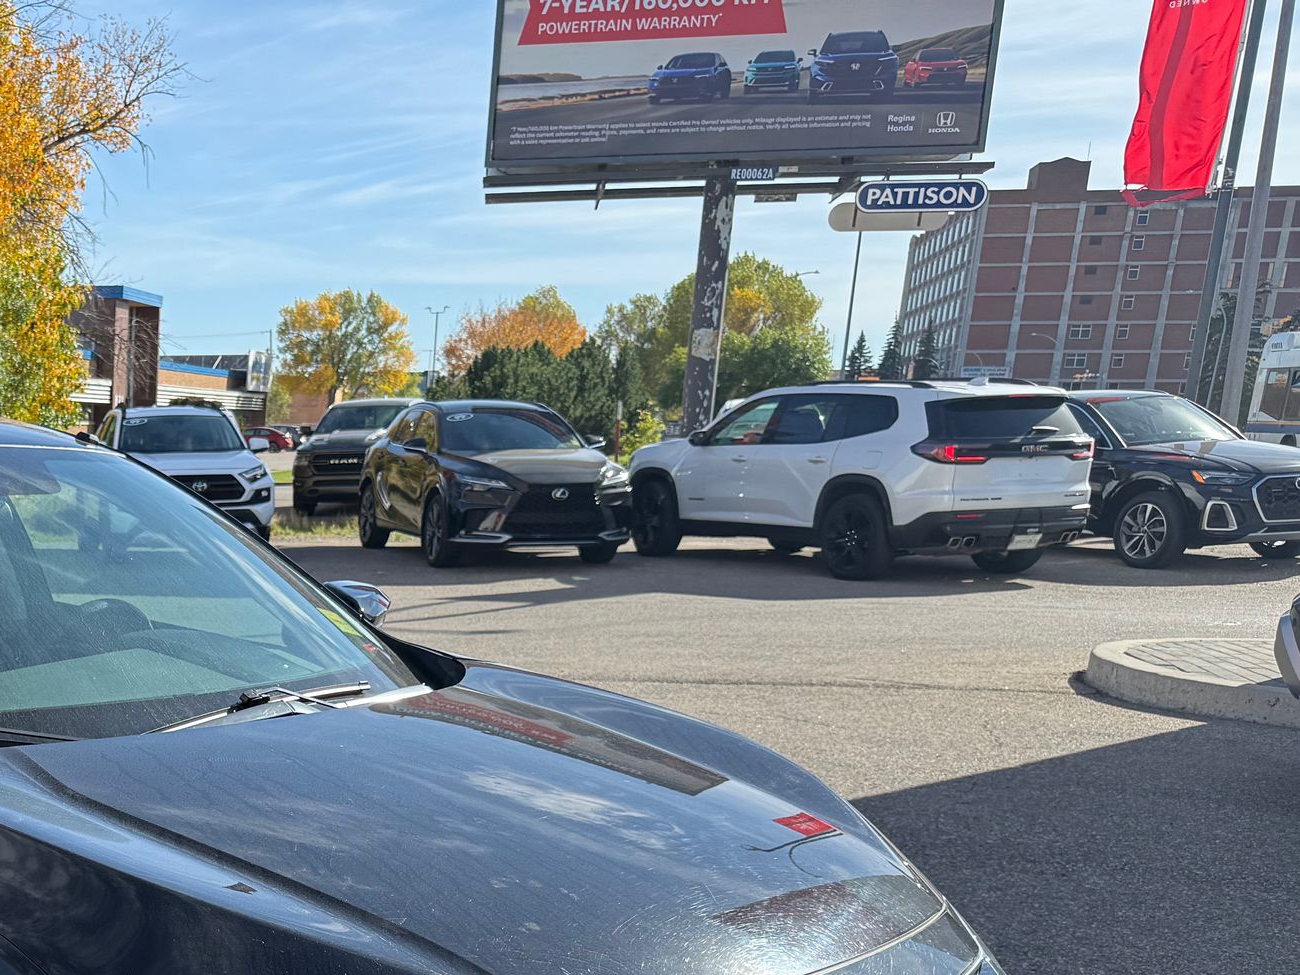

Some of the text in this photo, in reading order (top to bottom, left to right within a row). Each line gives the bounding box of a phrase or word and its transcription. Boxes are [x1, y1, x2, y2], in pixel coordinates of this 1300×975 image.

[538, 19, 632, 35] POWERTRAIN
[887, 114, 915, 123] Regina
[887, 124, 913, 132] Honda
[731, 168, 773, 179] RE00062A
[866, 186, 977, 205] PATTISON
[1022, 445, 1049, 453] GMC
